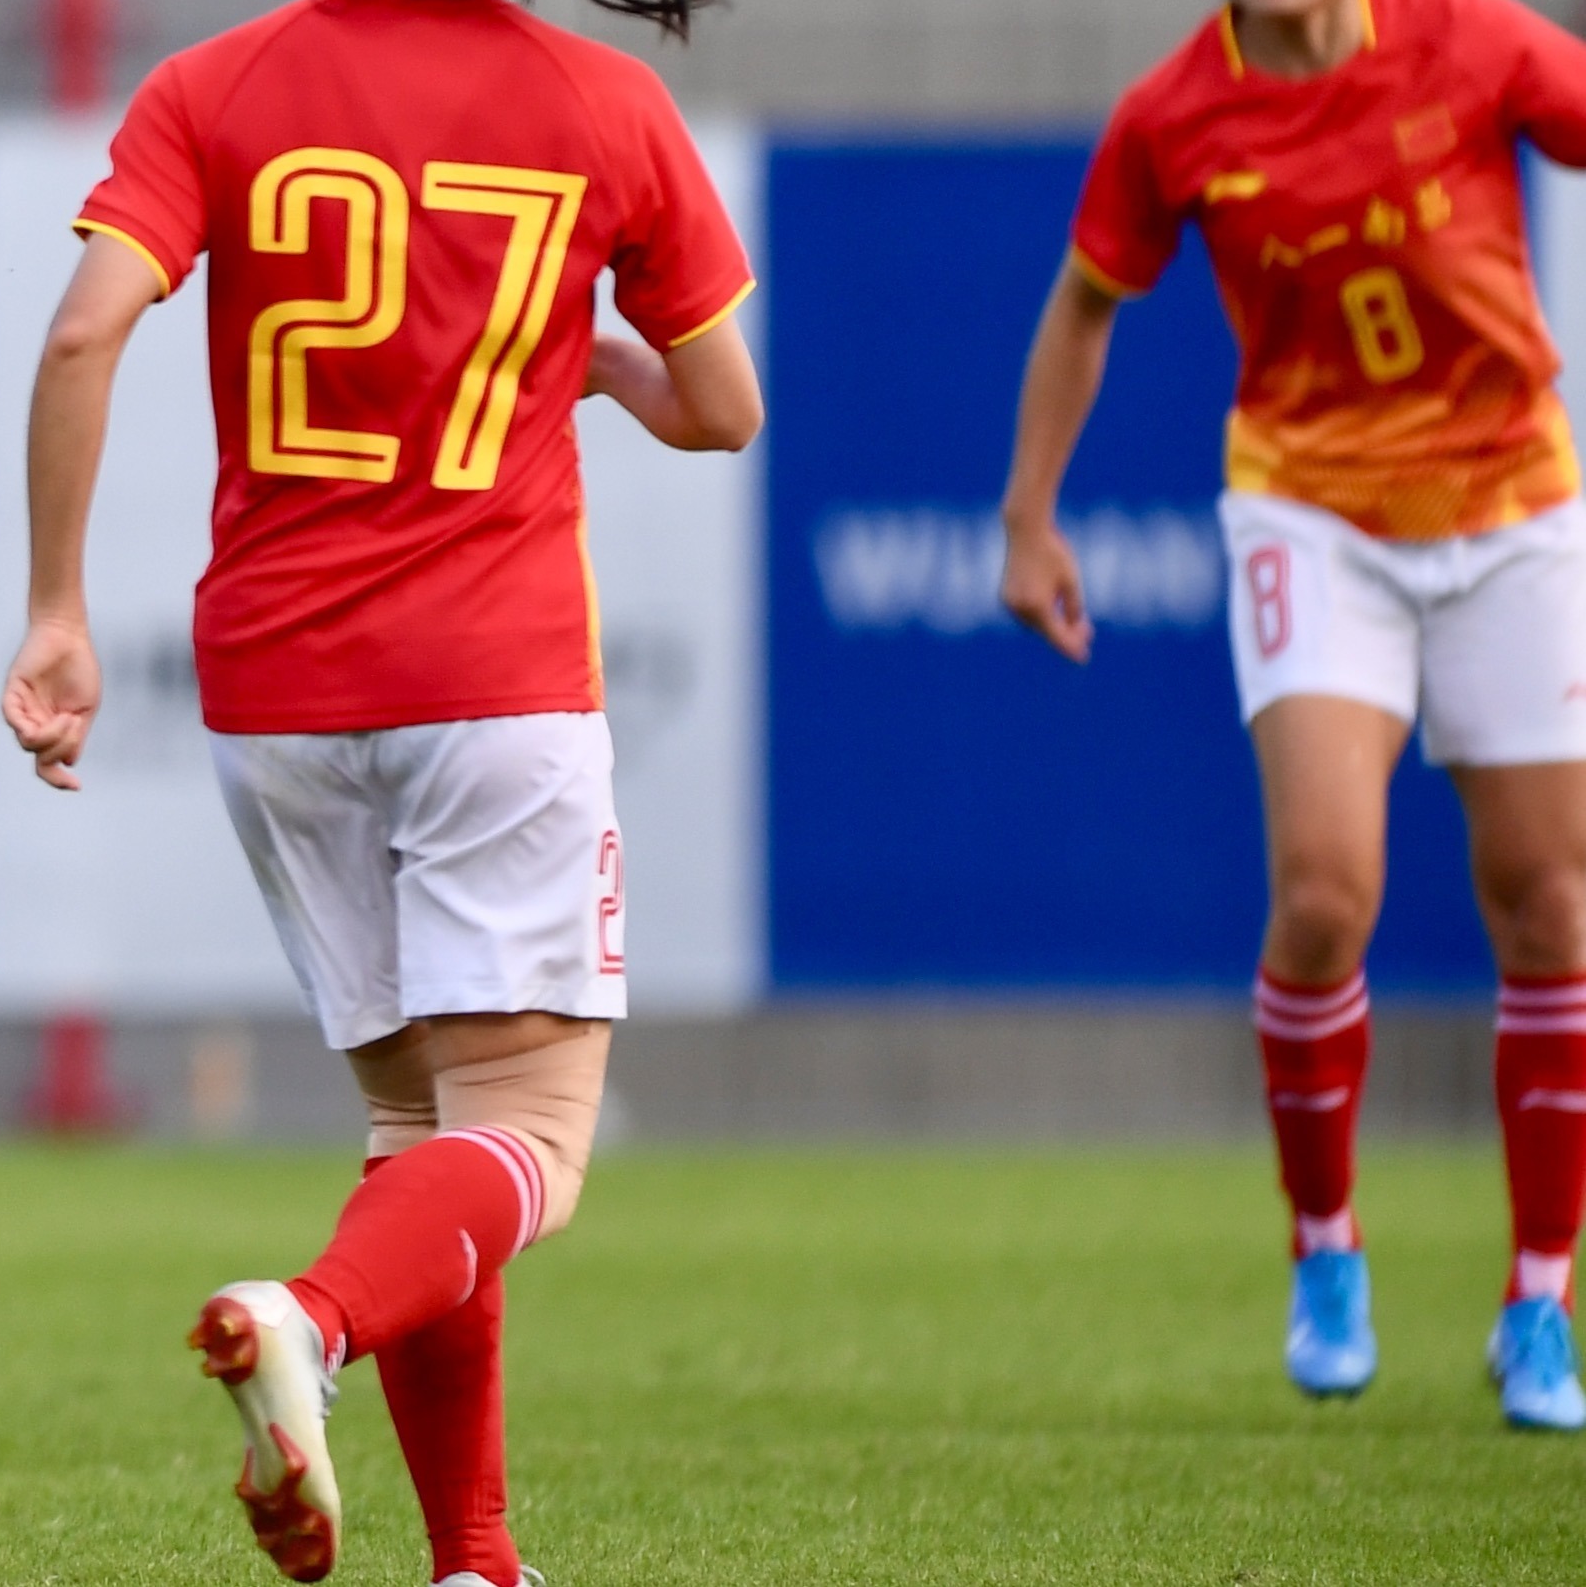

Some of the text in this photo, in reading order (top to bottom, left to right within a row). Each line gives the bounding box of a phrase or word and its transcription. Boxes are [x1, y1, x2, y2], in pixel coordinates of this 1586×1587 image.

[247, 146, 590, 491] 27
[1341, 266, 1425, 383] 8
[1247, 545, 1293, 659] 8
